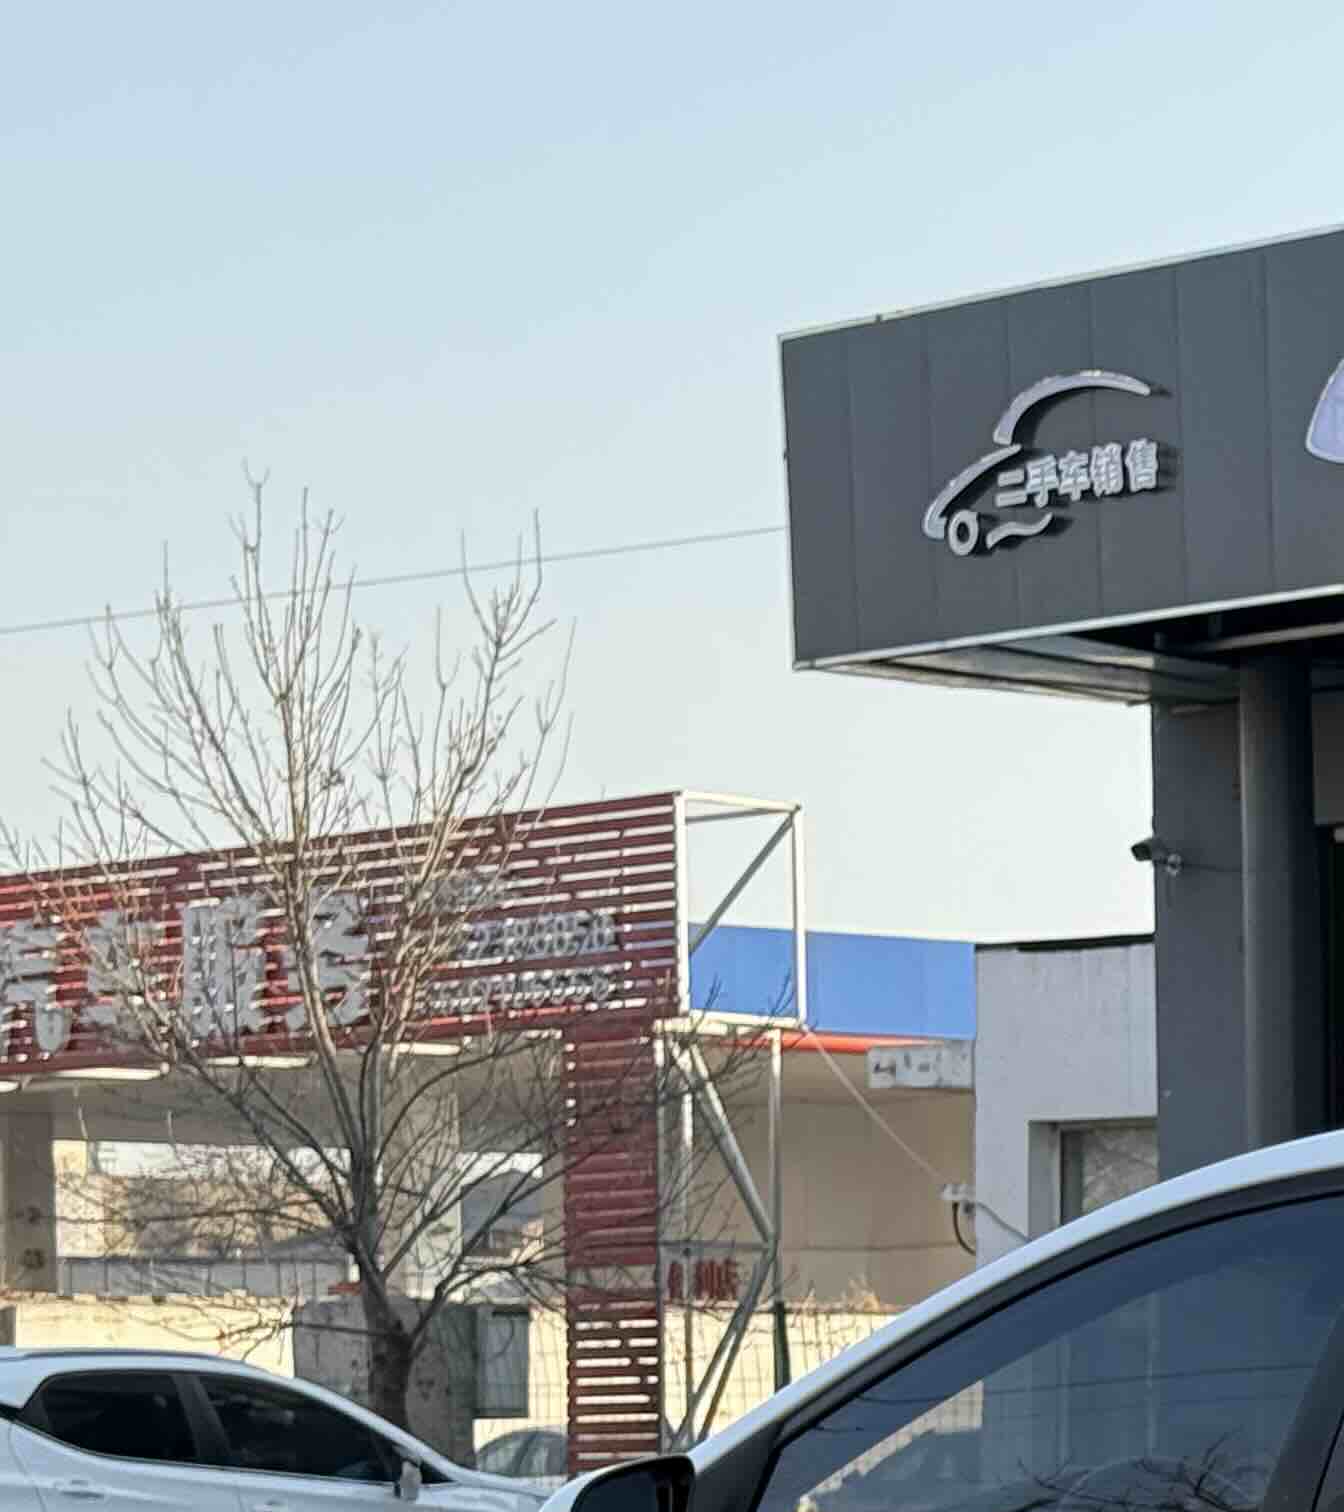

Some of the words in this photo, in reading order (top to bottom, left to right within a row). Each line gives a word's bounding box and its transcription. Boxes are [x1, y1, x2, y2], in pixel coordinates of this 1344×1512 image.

[995, 437, 1159, 509] 二手车销售
